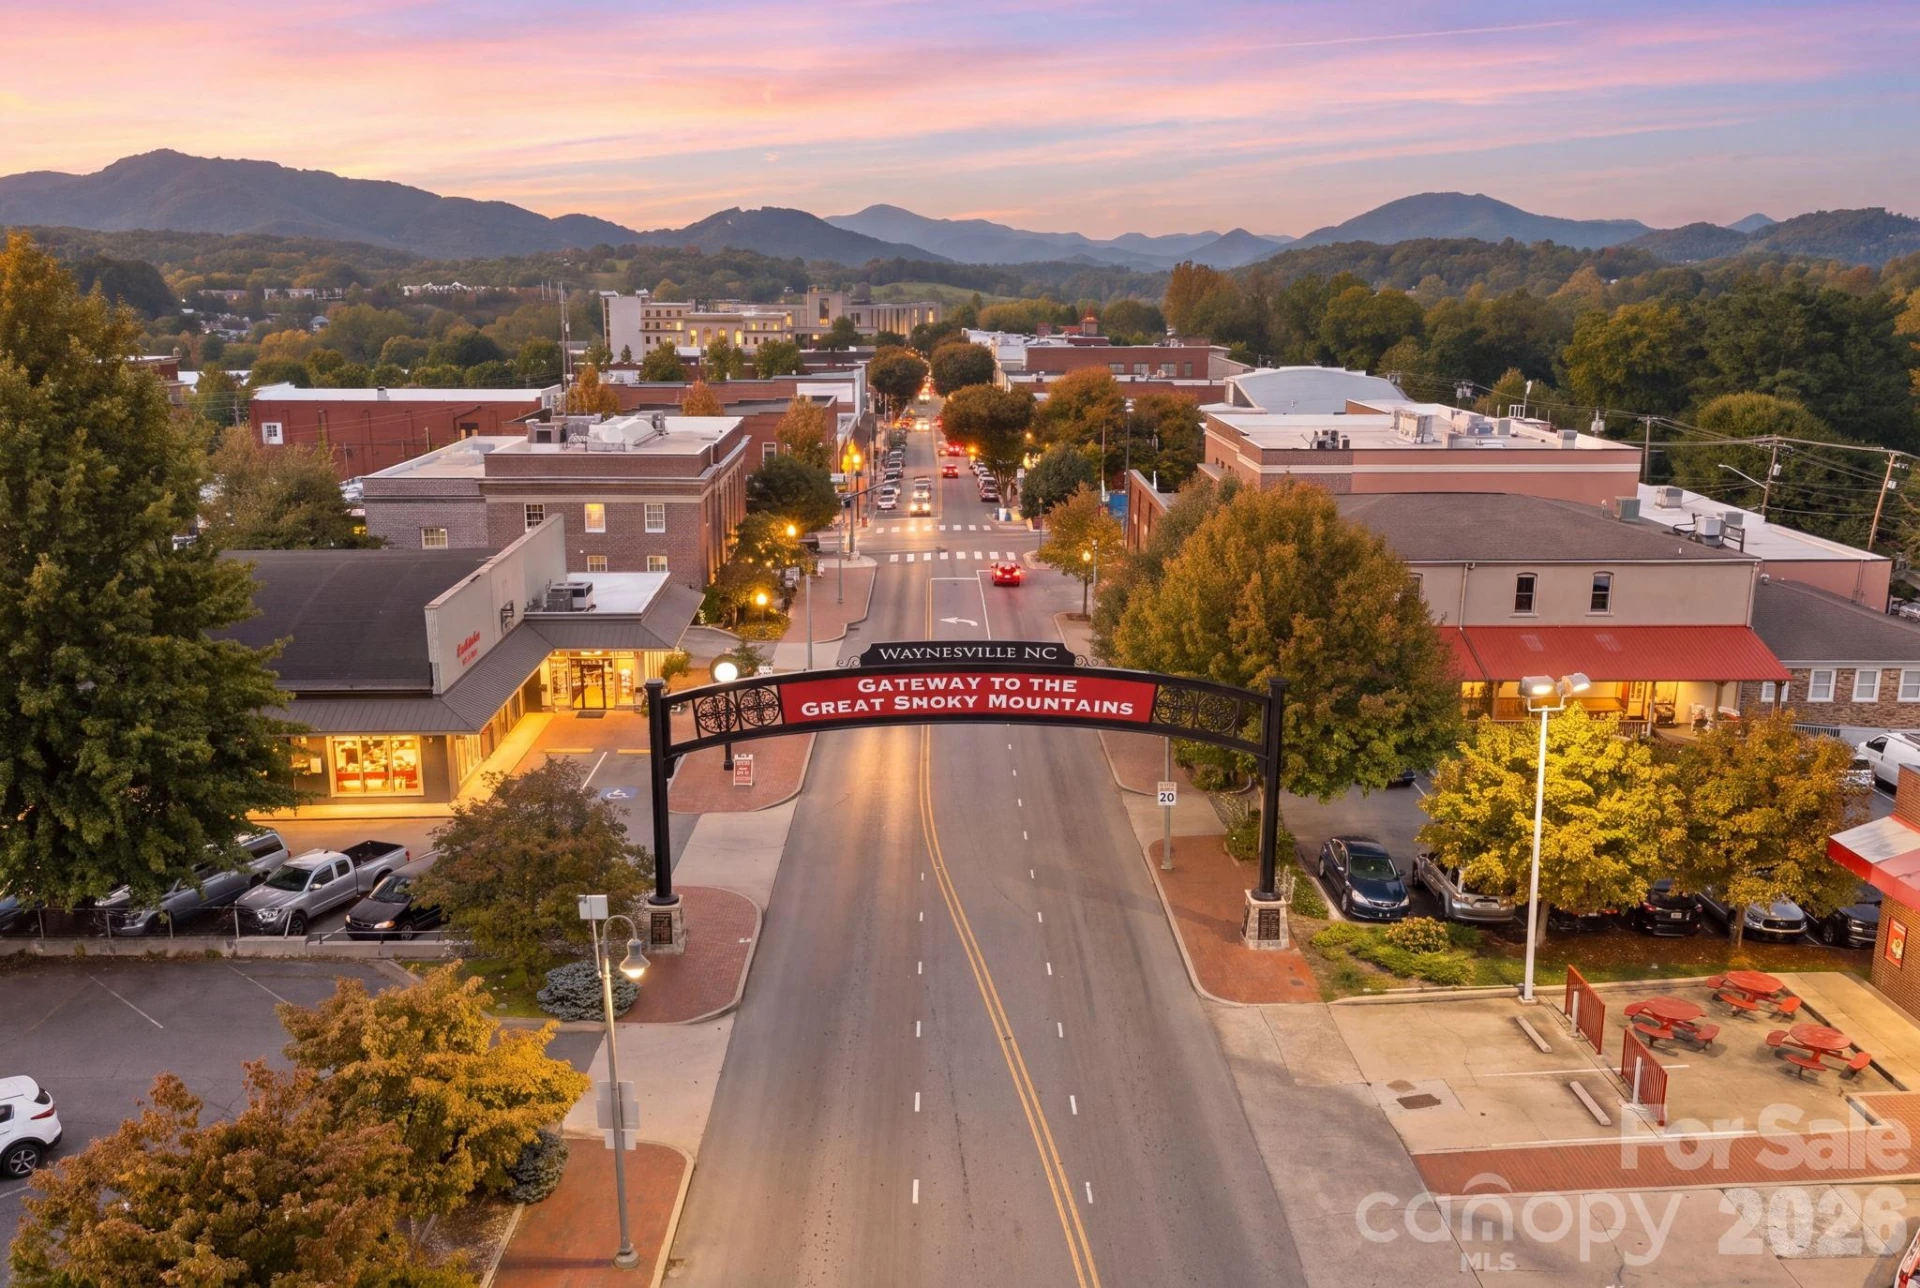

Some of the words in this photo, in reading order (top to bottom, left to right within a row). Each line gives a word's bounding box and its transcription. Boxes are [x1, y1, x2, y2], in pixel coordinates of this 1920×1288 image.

[879, 646, 1017, 660] WAYNESVILLE
[1024, 647, 1057, 660] NC
[857, 677, 981, 693] GATEWAY
[990, 677, 1021, 691] TO
[1029, 678, 1077, 693] THE
[801, 698, 885, 716] GREAT
[894, 695, 979, 710] SMOKY
[988, 694, 1134, 715] MOUNTAINS
[1160, 792, 1174, 802] 20
